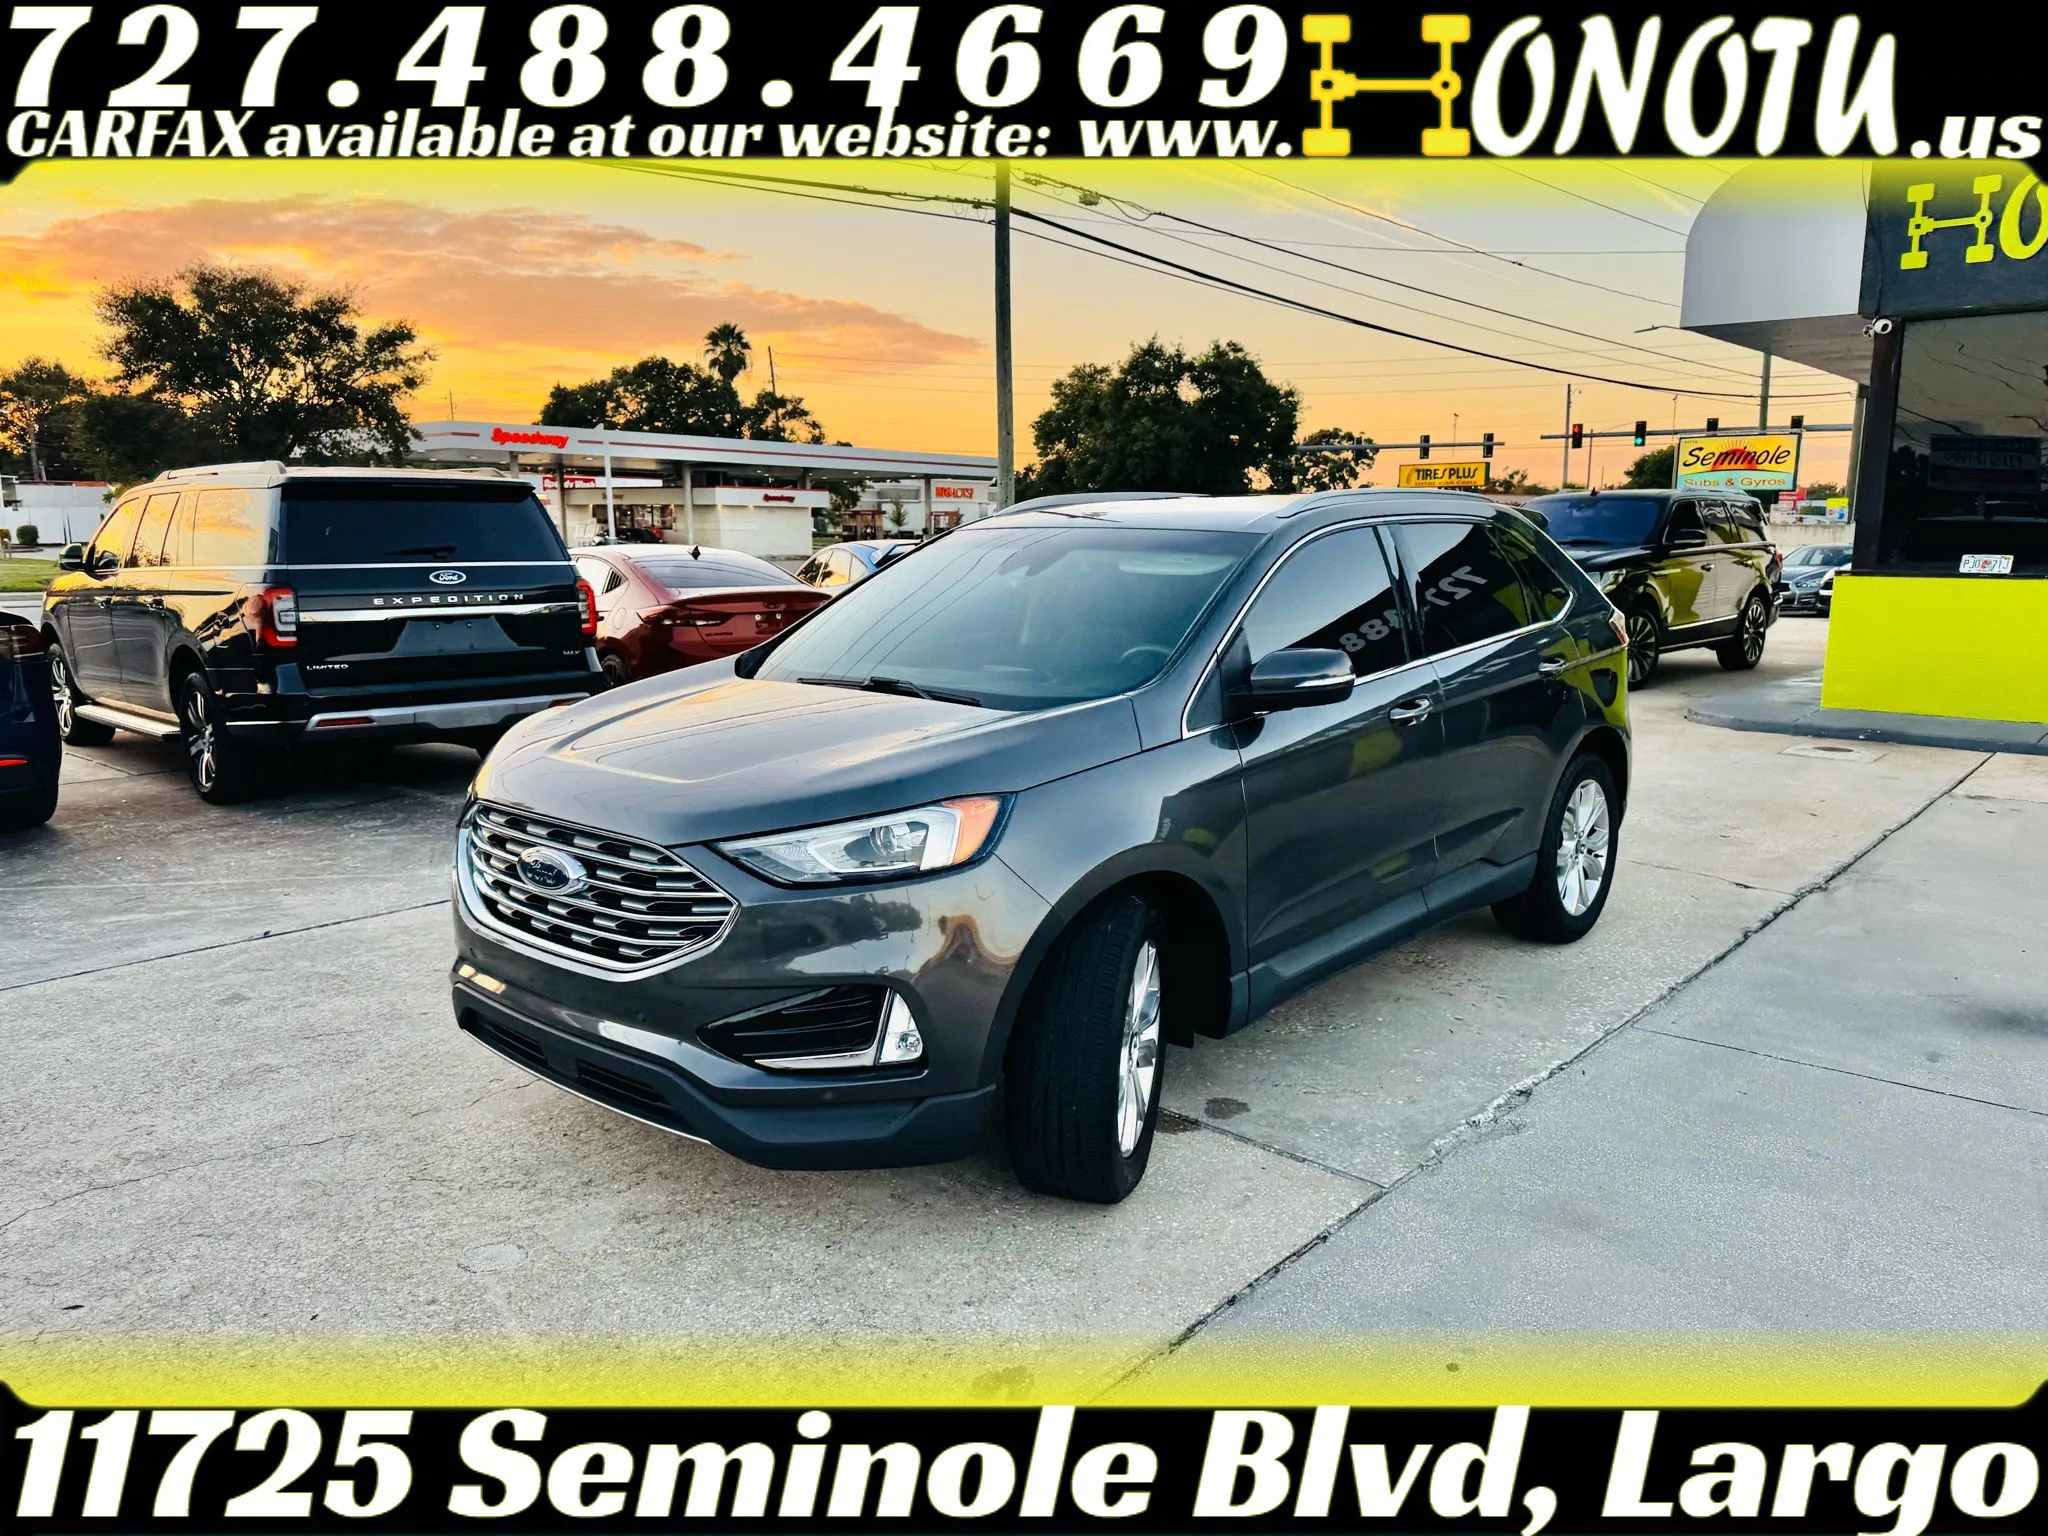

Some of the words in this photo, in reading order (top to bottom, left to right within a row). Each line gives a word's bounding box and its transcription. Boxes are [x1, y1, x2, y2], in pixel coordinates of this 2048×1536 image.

[1683, 445, 1791, 467] Seminole
[1415, 468, 1447, 480] TIRES
[1448, 467, 1478, 479] PLUS
[1684, 478, 1720, 487] Subs
[1724, 477, 1735, 486] &
[1740, 477, 1786, 488] Gyros
[438, 573, 459, 581] Ford
[373, 594, 524, 605] EXPEDITION
